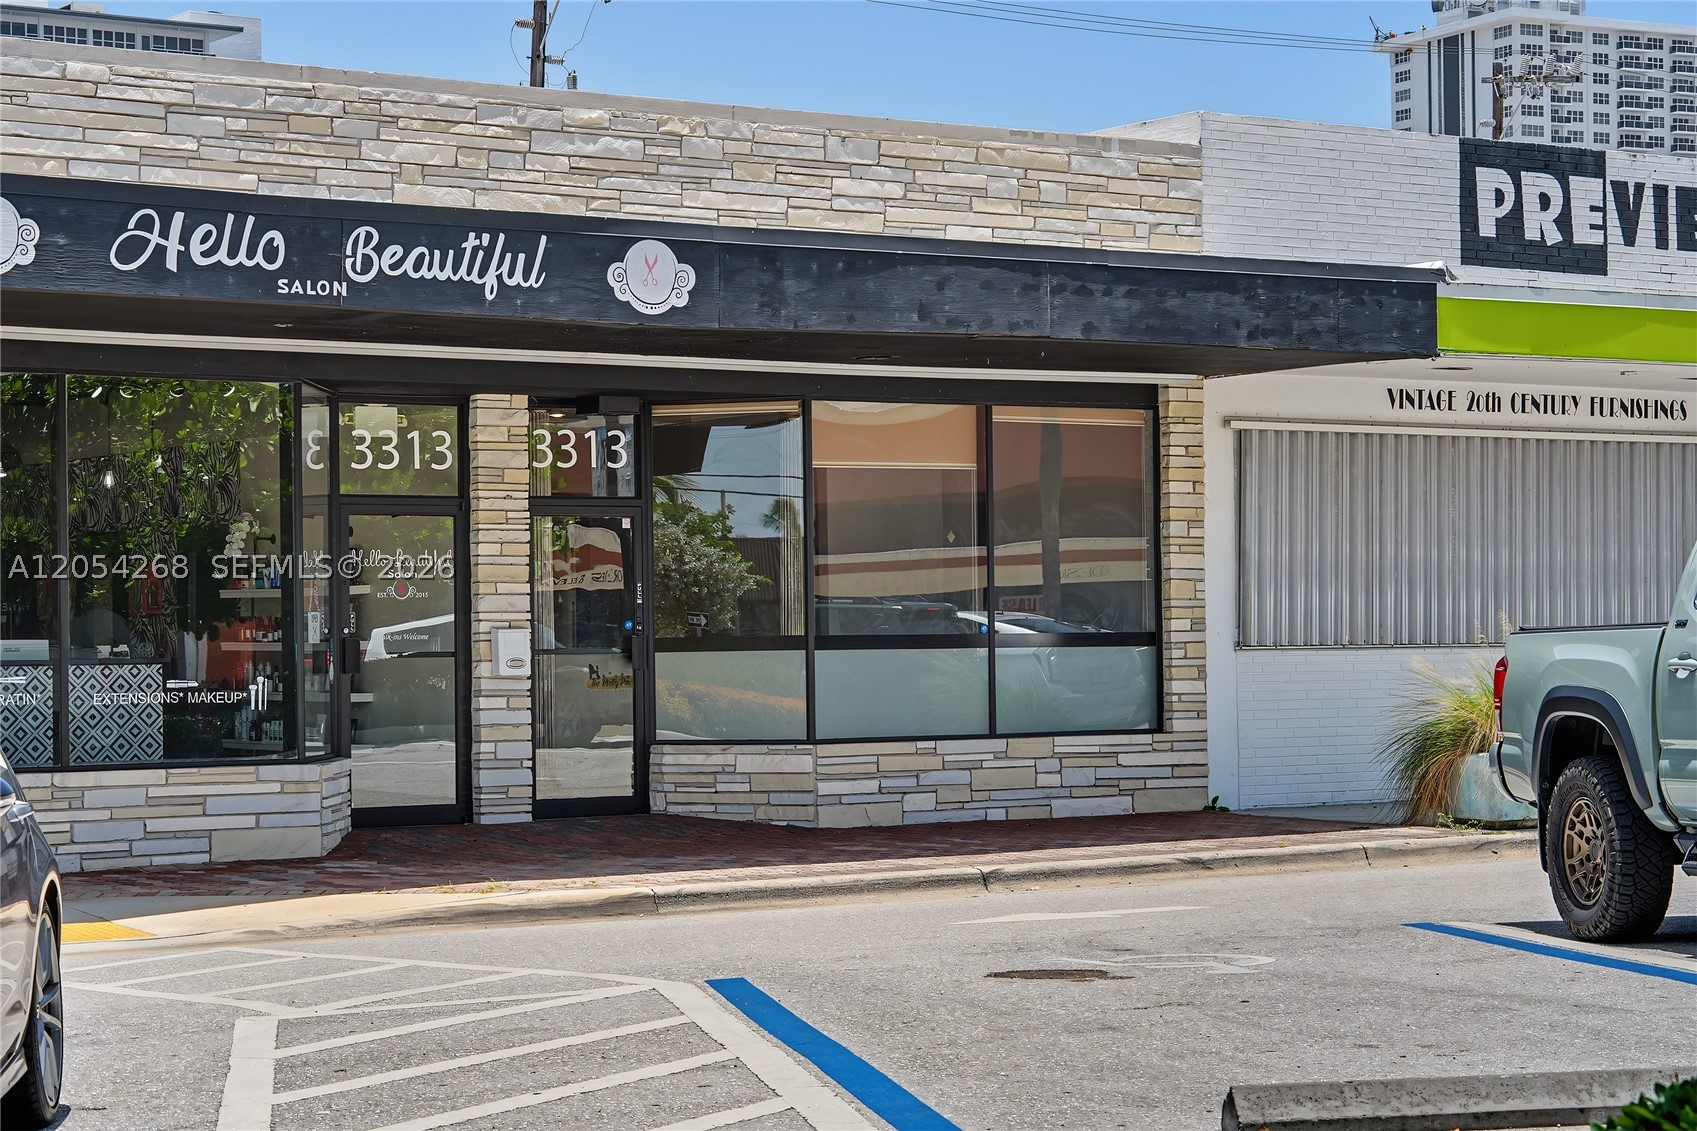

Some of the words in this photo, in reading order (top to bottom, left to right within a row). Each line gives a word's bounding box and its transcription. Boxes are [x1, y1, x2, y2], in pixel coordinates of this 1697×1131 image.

[109, 208, 286, 273] Hello
[345, 225, 547, 300] Beautiful
[277, 278, 347, 297] SALON
[1387, 387, 1457, 412] VINTAGE
[1511, 392, 1582, 416] CENTURY
[1590, 397, 1687, 421] FURNISHINGS
[350, 429, 453, 471] 3313
[532, 429, 628, 469] 3313
[350, 549, 388, 568] Hello
